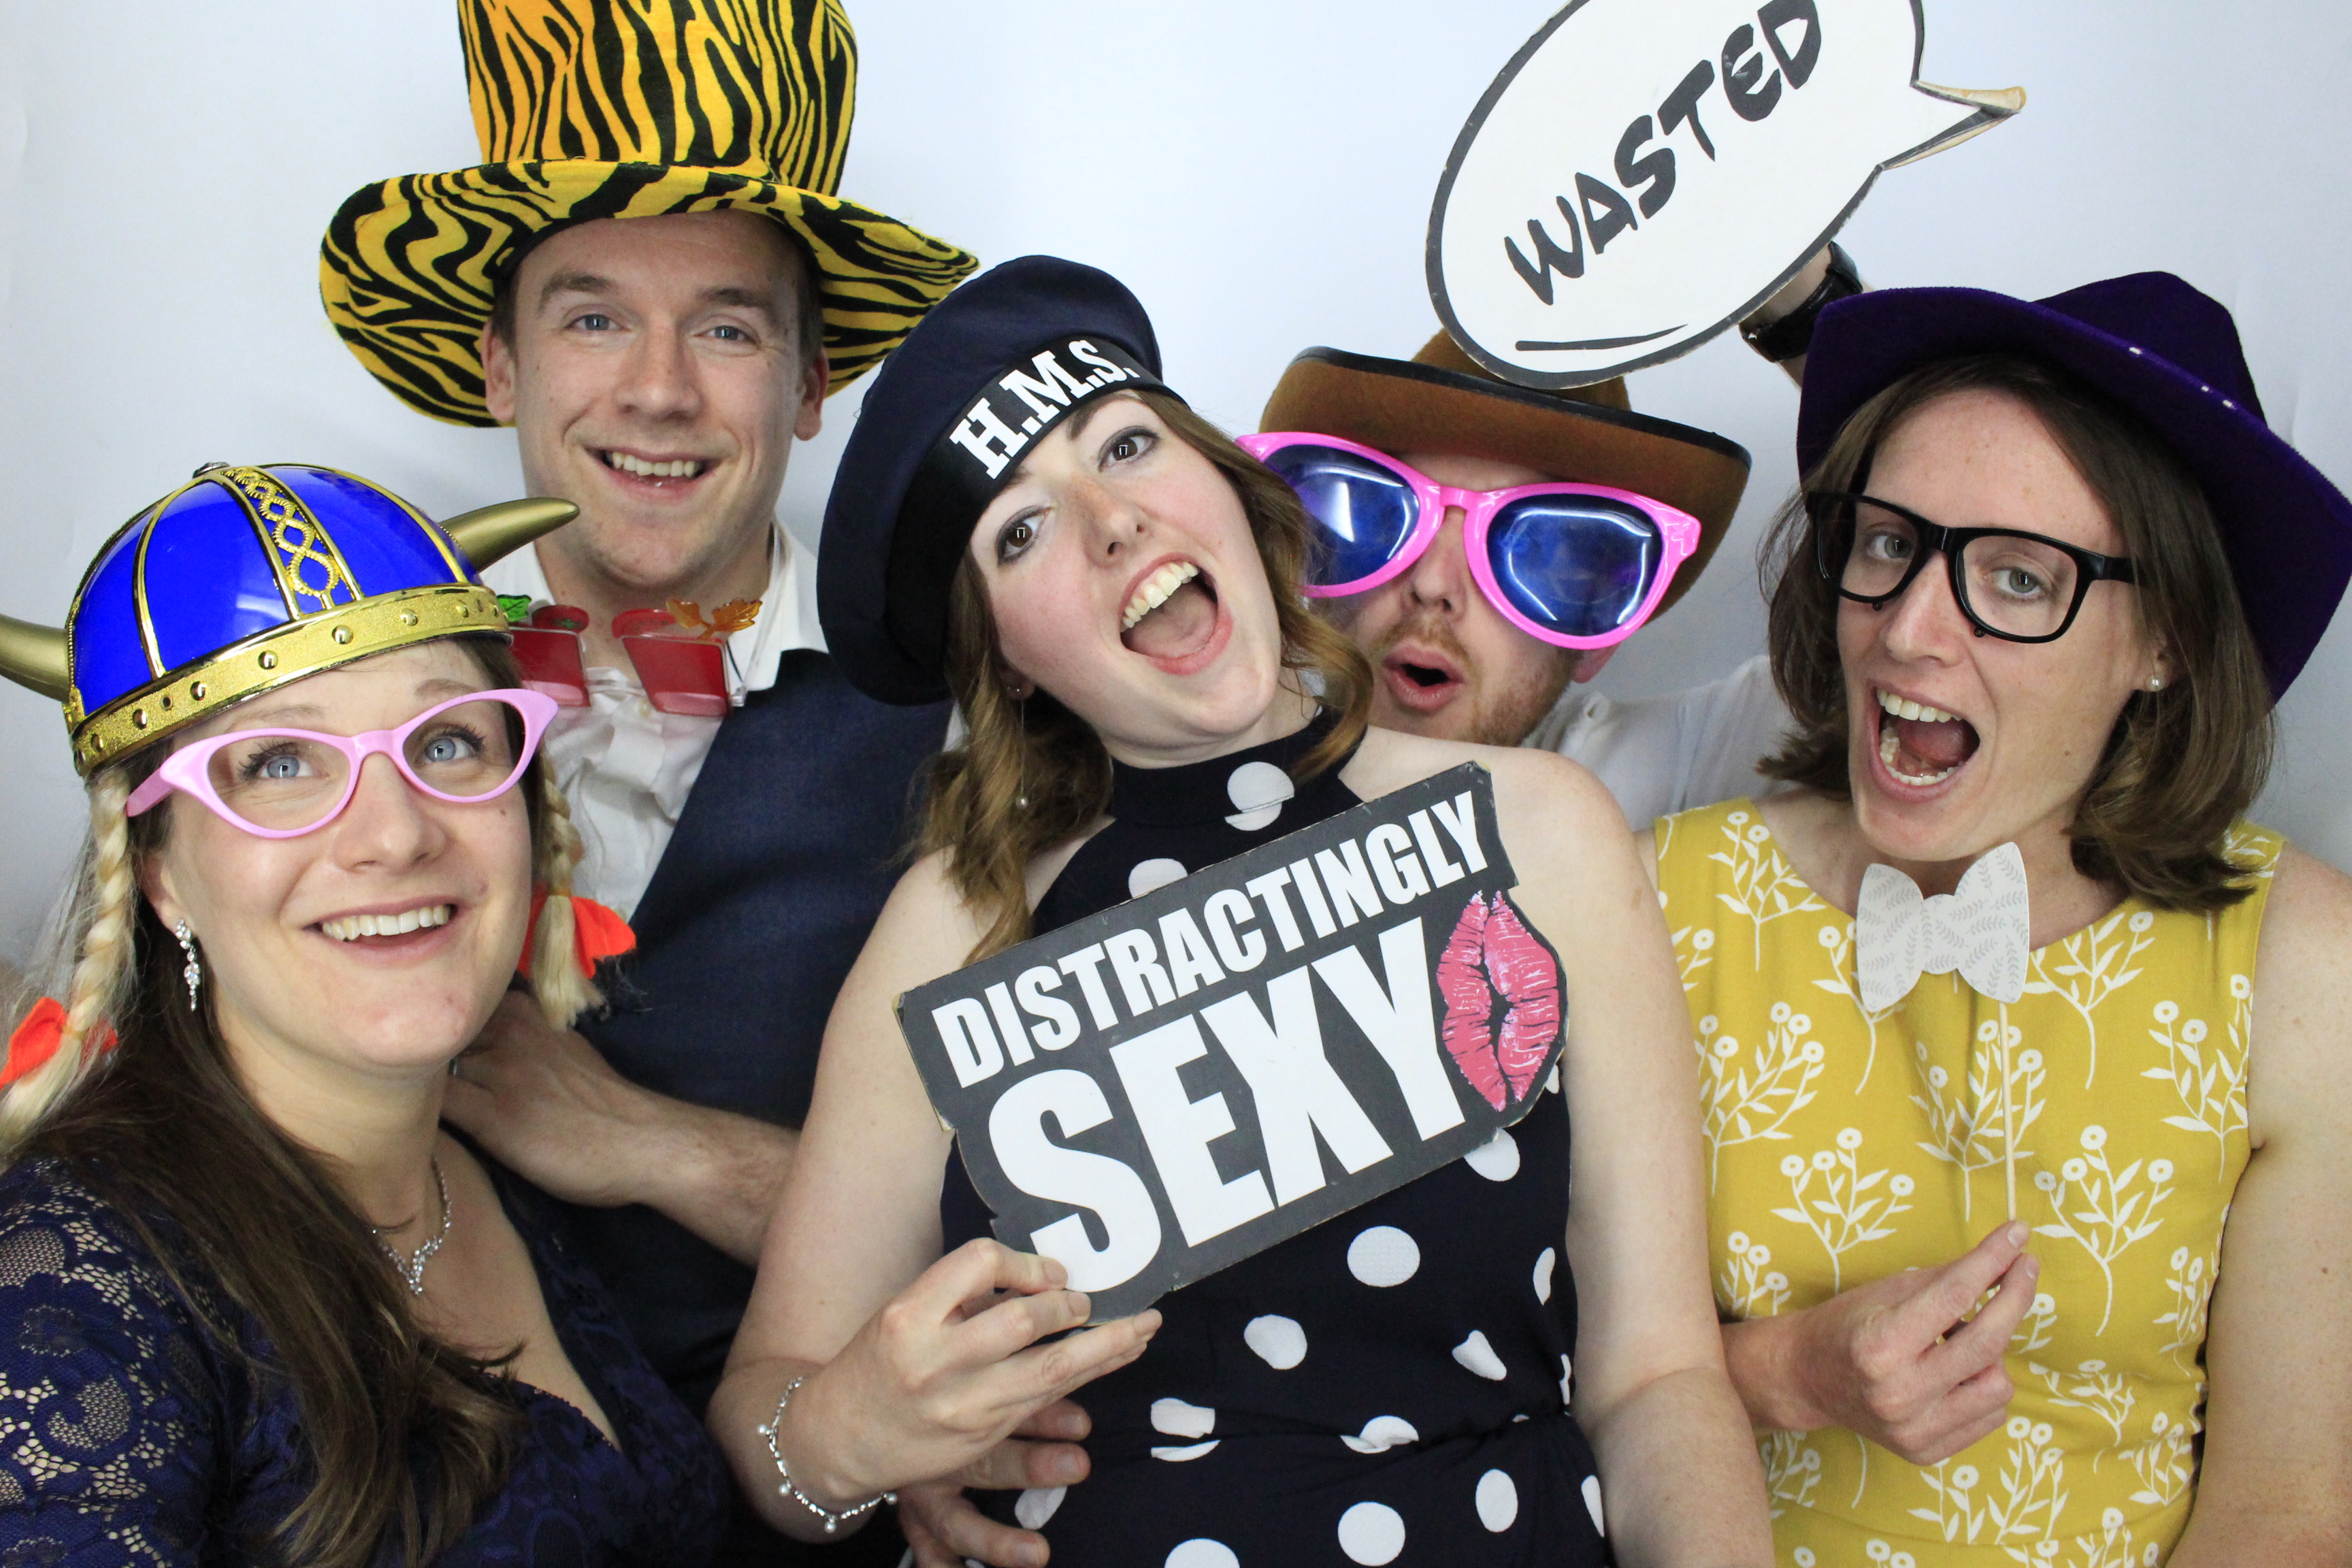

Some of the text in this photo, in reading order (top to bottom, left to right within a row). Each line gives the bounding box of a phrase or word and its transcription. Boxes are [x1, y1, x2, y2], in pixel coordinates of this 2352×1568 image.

[1505, 0, 1822, 306] WASTED
[949, 340, 1141, 479] H.M.S.
[931, 790, 1490, 1089] DISTRACTINGLY
[988, 917, 1466, 1293] SEXY
